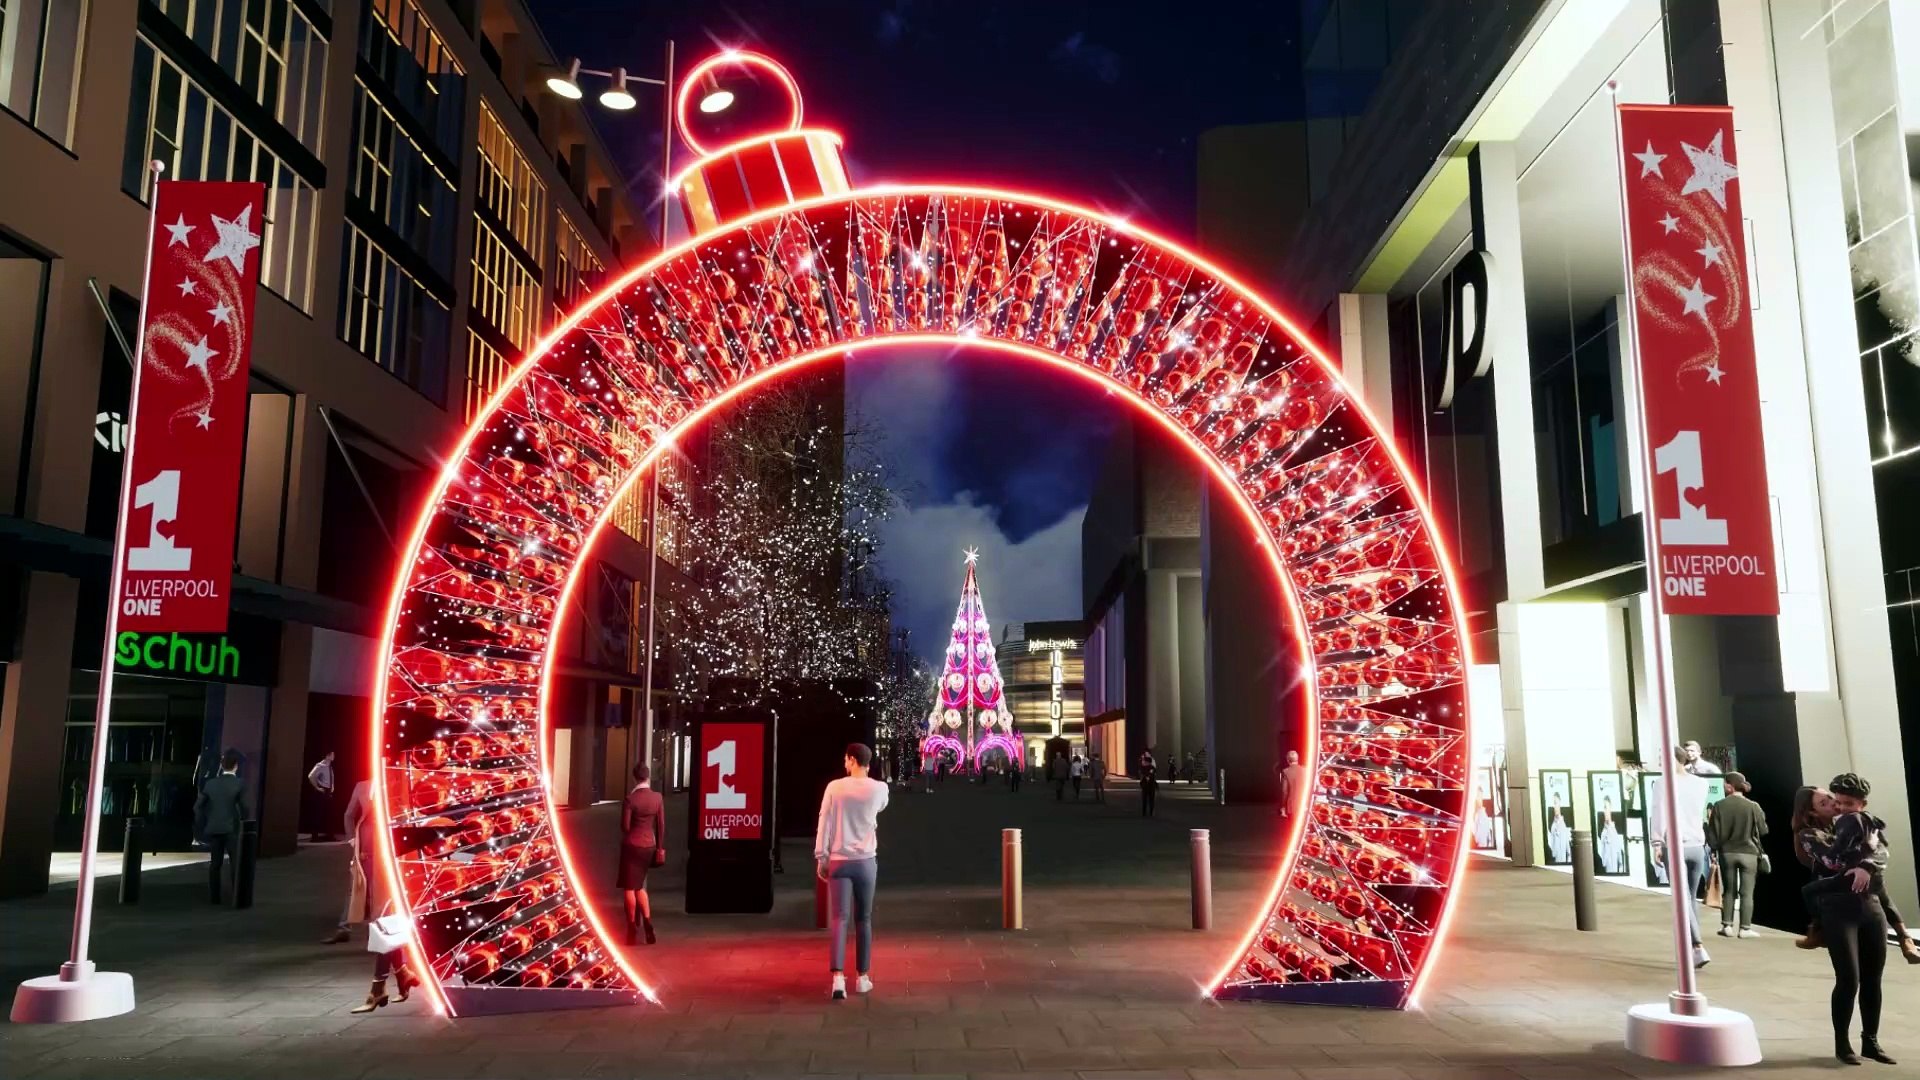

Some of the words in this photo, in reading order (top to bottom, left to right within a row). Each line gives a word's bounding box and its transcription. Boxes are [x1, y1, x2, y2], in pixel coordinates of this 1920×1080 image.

[1655, 430, 1729, 545] 1
[127, 470, 192, 571] 1
[1663, 555, 1765, 576] LIVERPOOL
[124, 580, 219, 597] LIVERPOOL
[1664, 577, 1707, 597] ONE
[123, 599, 162, 616] ONE
[115, 632, 240, 677] schuh
[706, 740, 746, 809] 1
[704, 828, 729, 840] ONE
